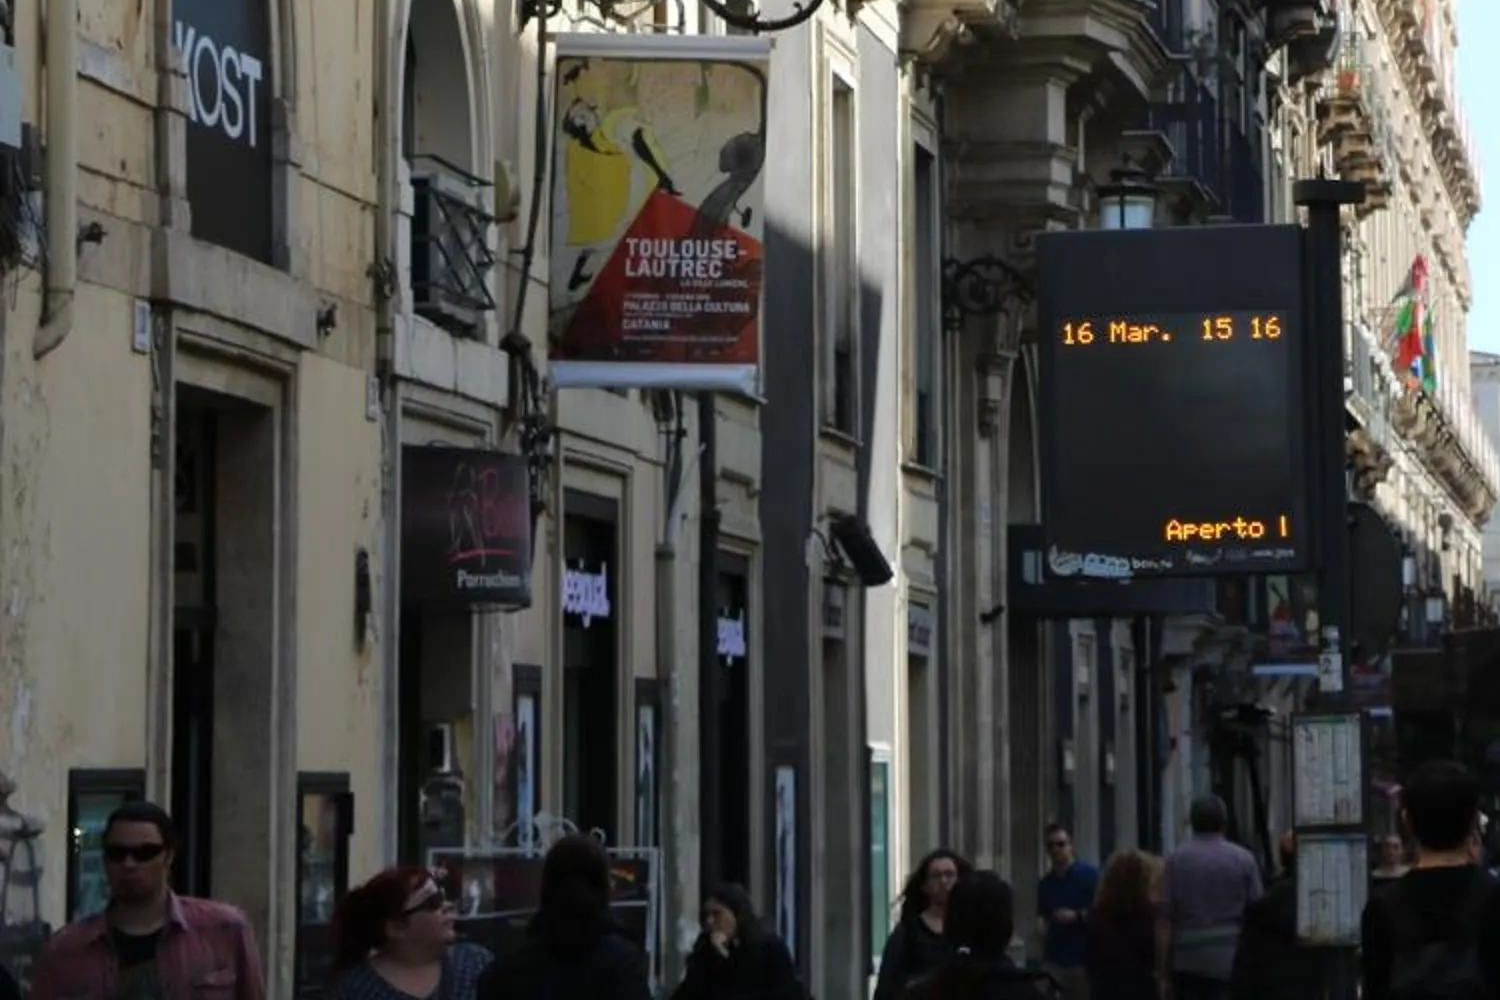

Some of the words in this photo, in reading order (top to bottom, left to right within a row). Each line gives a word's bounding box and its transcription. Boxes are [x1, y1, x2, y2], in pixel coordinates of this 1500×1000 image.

[625, 237, 749, 260] TOULOUSE-
[624, 258, 724, 278] LAUTREC
[669, 301, 702, 313] DELLA
[703, 301, 751, 314] CULTURA
[623, 318, 671, 330] CATANIA
[1062, 321, 1095, 345] 16
[1109, 320, 1172, 344] Mar.
[1201, 317, 1233, 341] 15
[1250, 316, 1281, 340] 16
[1166, 515, 1265, 541] Aperto
